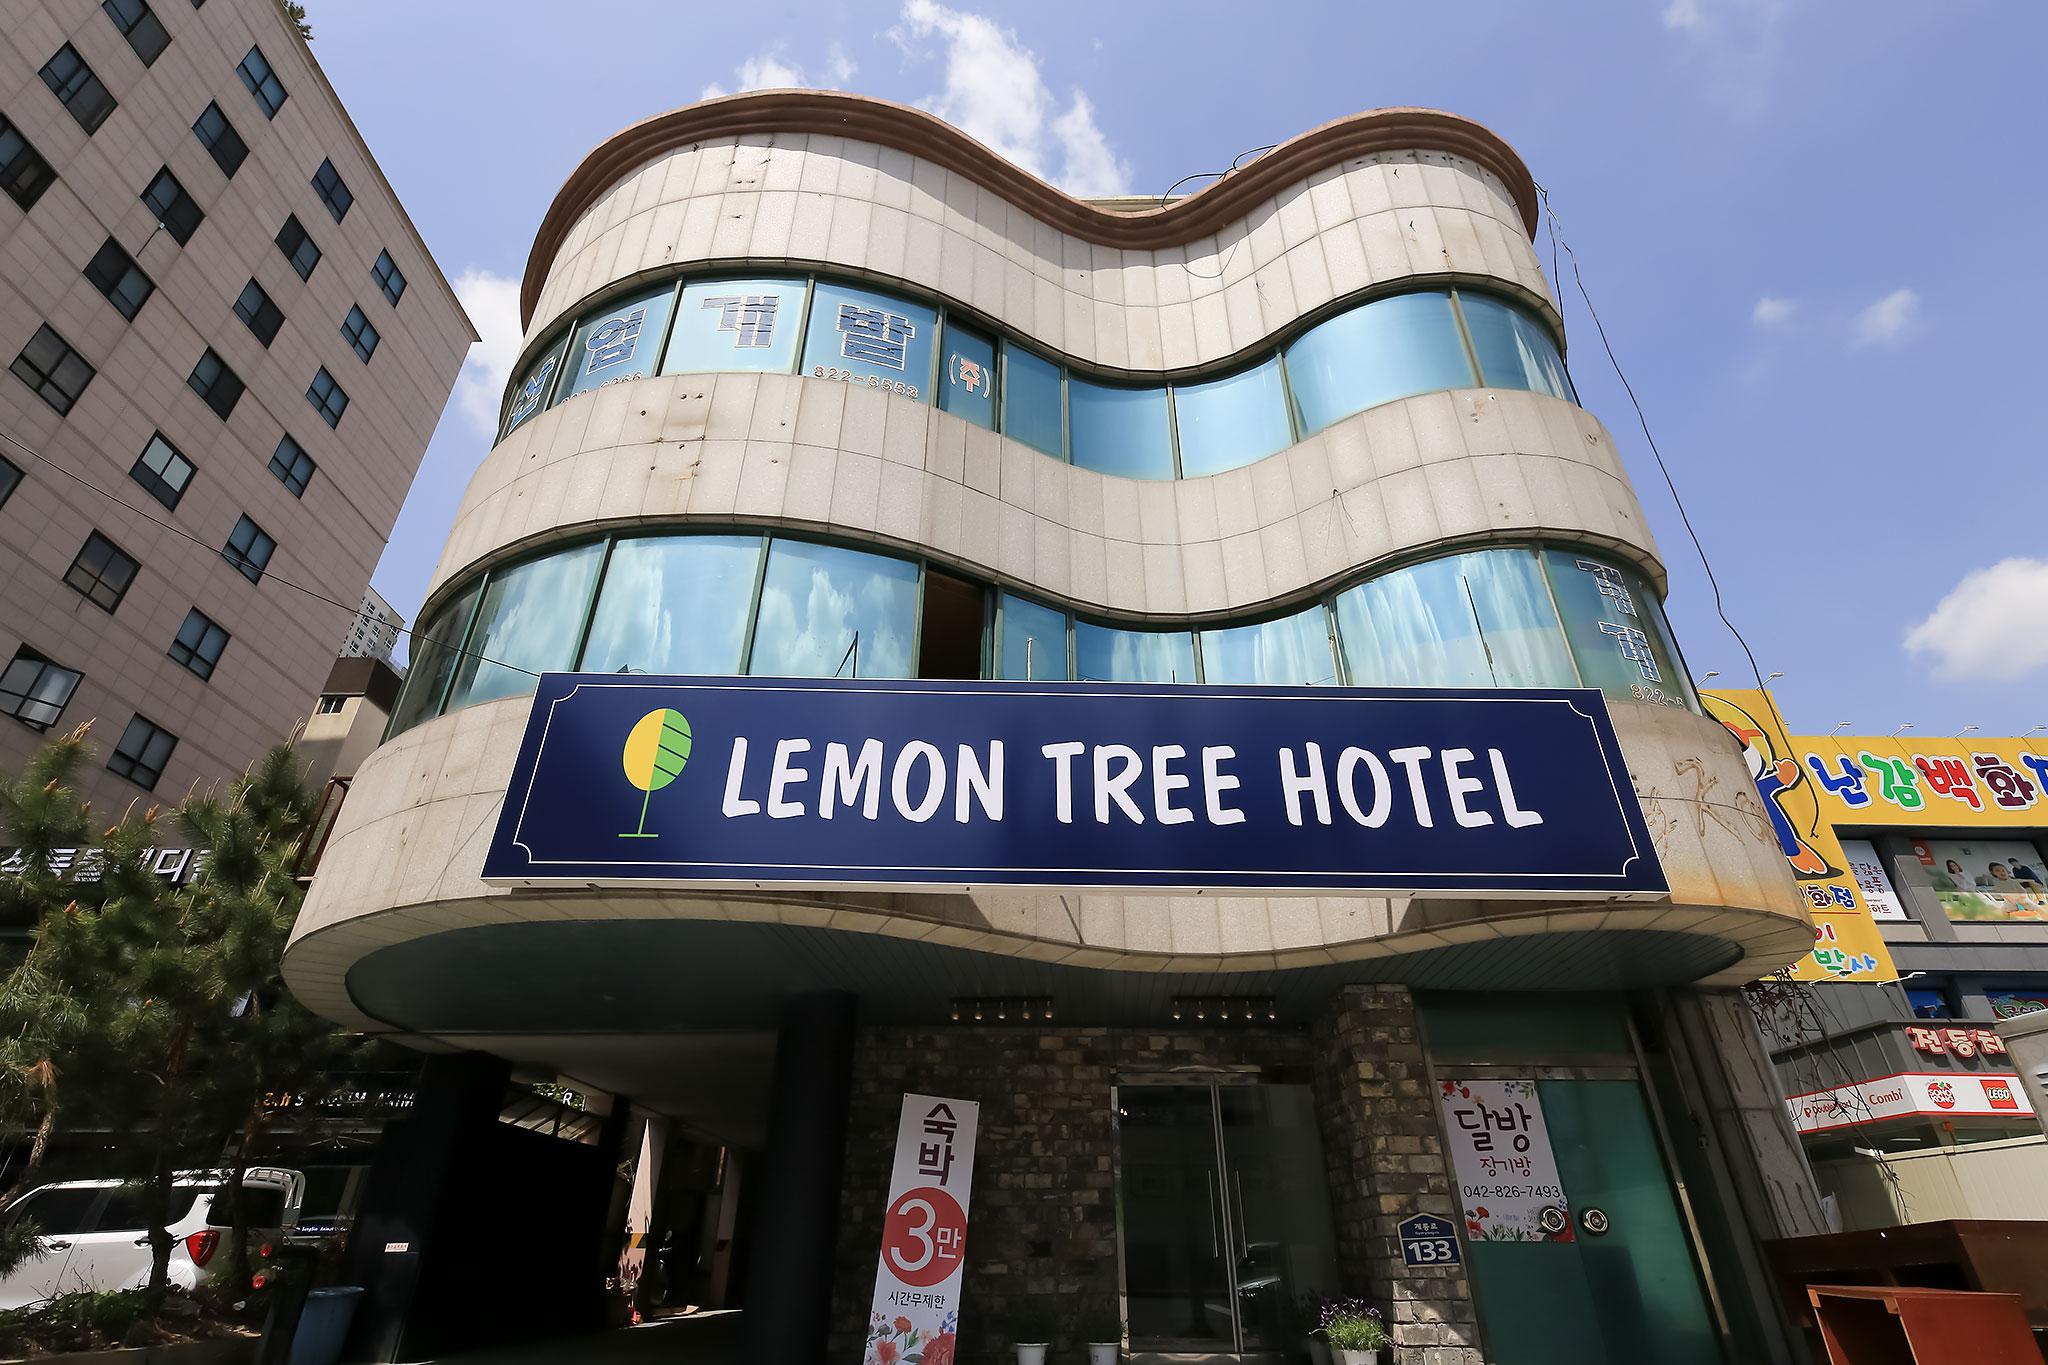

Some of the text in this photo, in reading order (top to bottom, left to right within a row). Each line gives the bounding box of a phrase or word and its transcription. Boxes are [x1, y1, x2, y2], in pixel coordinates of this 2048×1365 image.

[949, 354, 990, 399] (주)
[721, 736, 1544, 829] LEMON TREE HOTEL
[1868, 1088, 1904, 1106] Combi
[1987, 1087, 2011, 1101] LEGO
[1454, 1102, 1533, 1153] 달방
[918, 1103, 958, 1186] 숙박
[1479, 1156, 1532, 1177] 장기방
[1463, 1184, 1561, 1199] 042-826-7493
[1407, 1240, 1453, 1262] 133
[887, 1291, 946, 1309] 시간무제한
